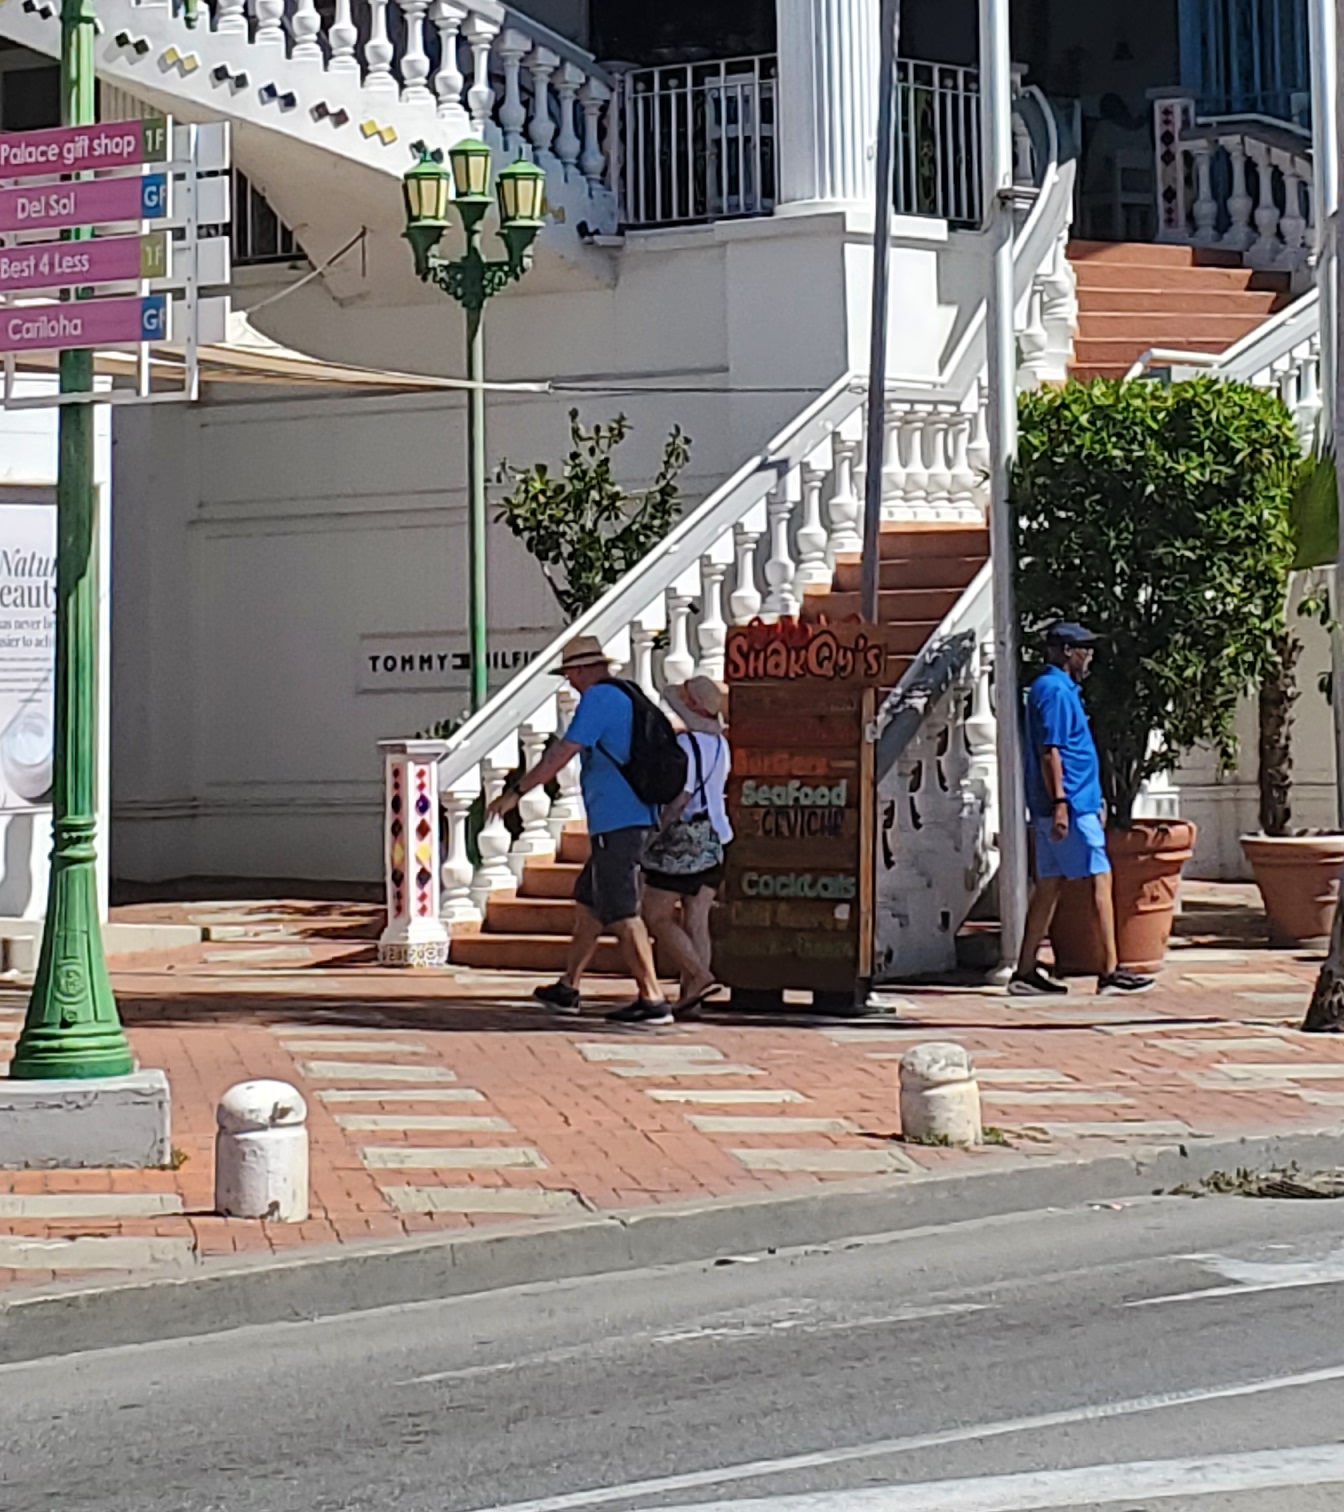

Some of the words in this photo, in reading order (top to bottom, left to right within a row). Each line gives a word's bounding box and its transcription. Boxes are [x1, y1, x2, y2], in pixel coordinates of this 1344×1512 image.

[0, 141, 60, 166] Palace
[63, 134, 90, 164] gift
[93, 131, 135, 158] shop
[145, 129, 164, 153] 1F
[17, 196, 45, 219] Del
[49, 192, 75, 217] Sol
[0, 255, 37, 280] Best
[39, 256, 50, 275] 4
[55, 251, 90, 273] Less
[8, 316, 83, 340] Cariloha
[14, 620, 42, 630] never
[369, 653, 447, 672] TOMMY
[741, 779, 847, 807] Seafood
